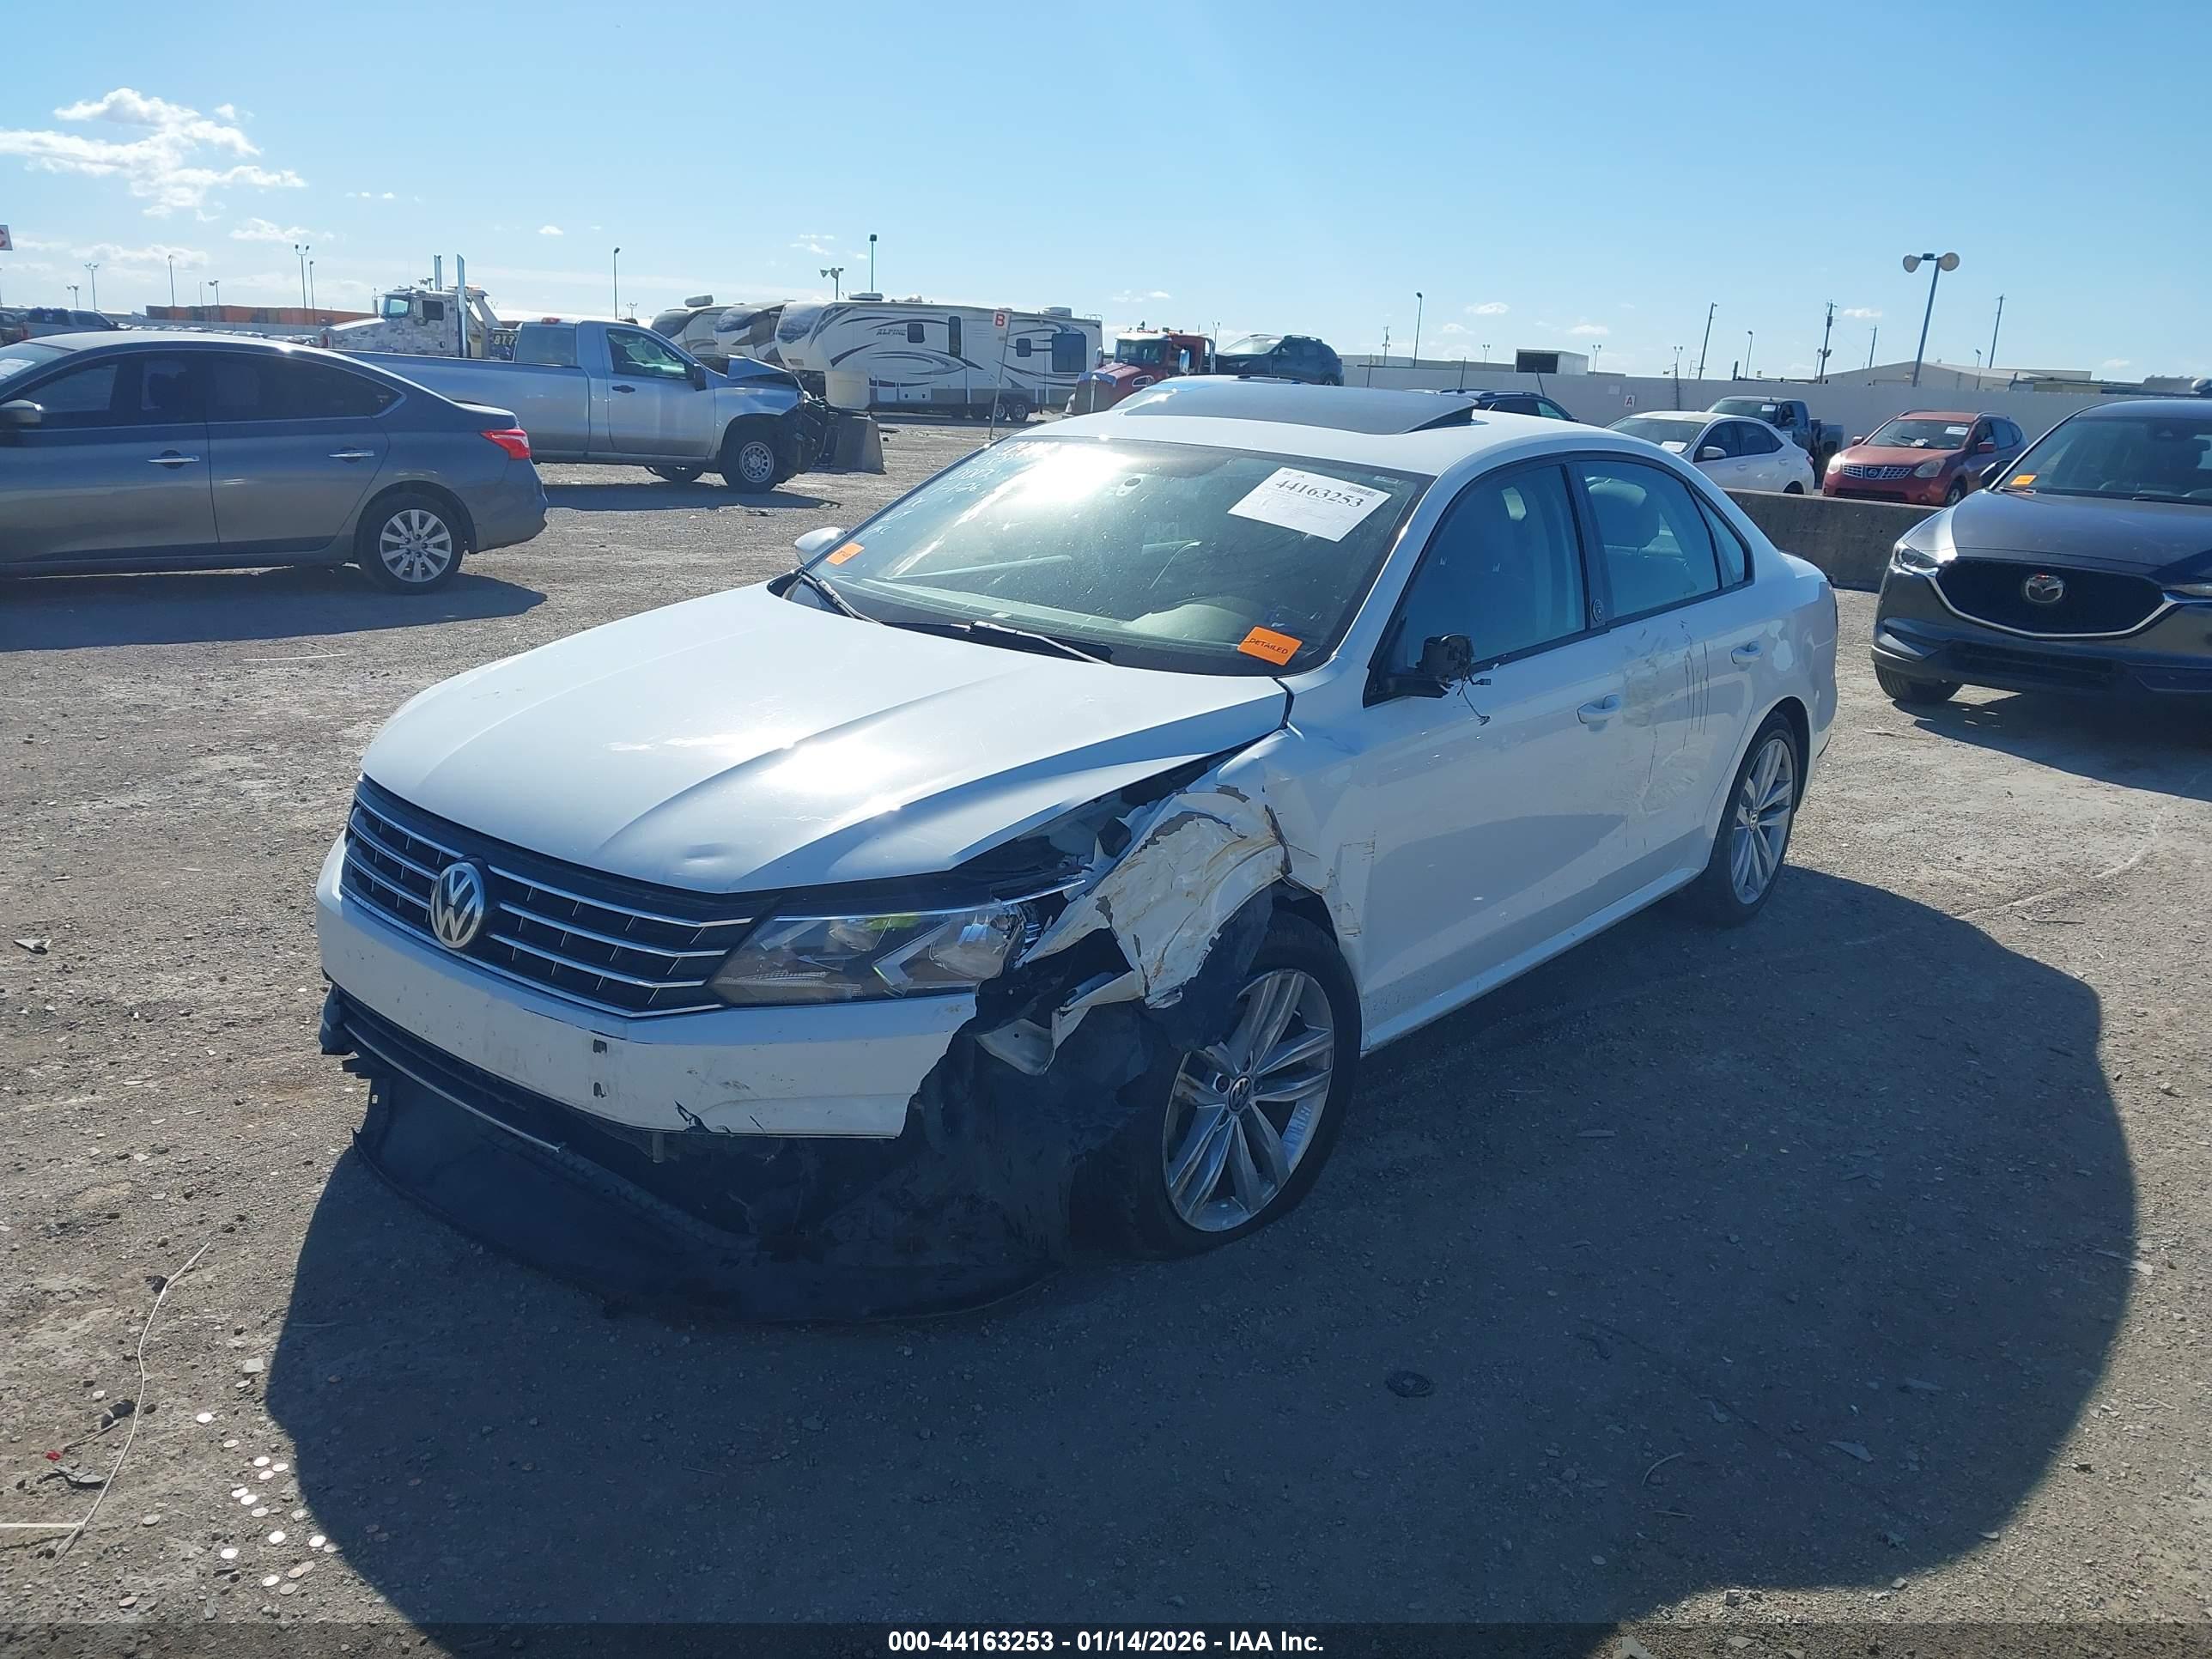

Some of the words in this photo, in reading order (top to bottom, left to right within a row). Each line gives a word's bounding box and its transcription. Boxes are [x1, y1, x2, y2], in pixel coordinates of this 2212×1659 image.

[994, 313, 1005, 327] B
[1626, 396, 1633, 406] A
[1275, 480, 1364, 507] 44163253
[1249, 637, 1288, 654] DETAILED
